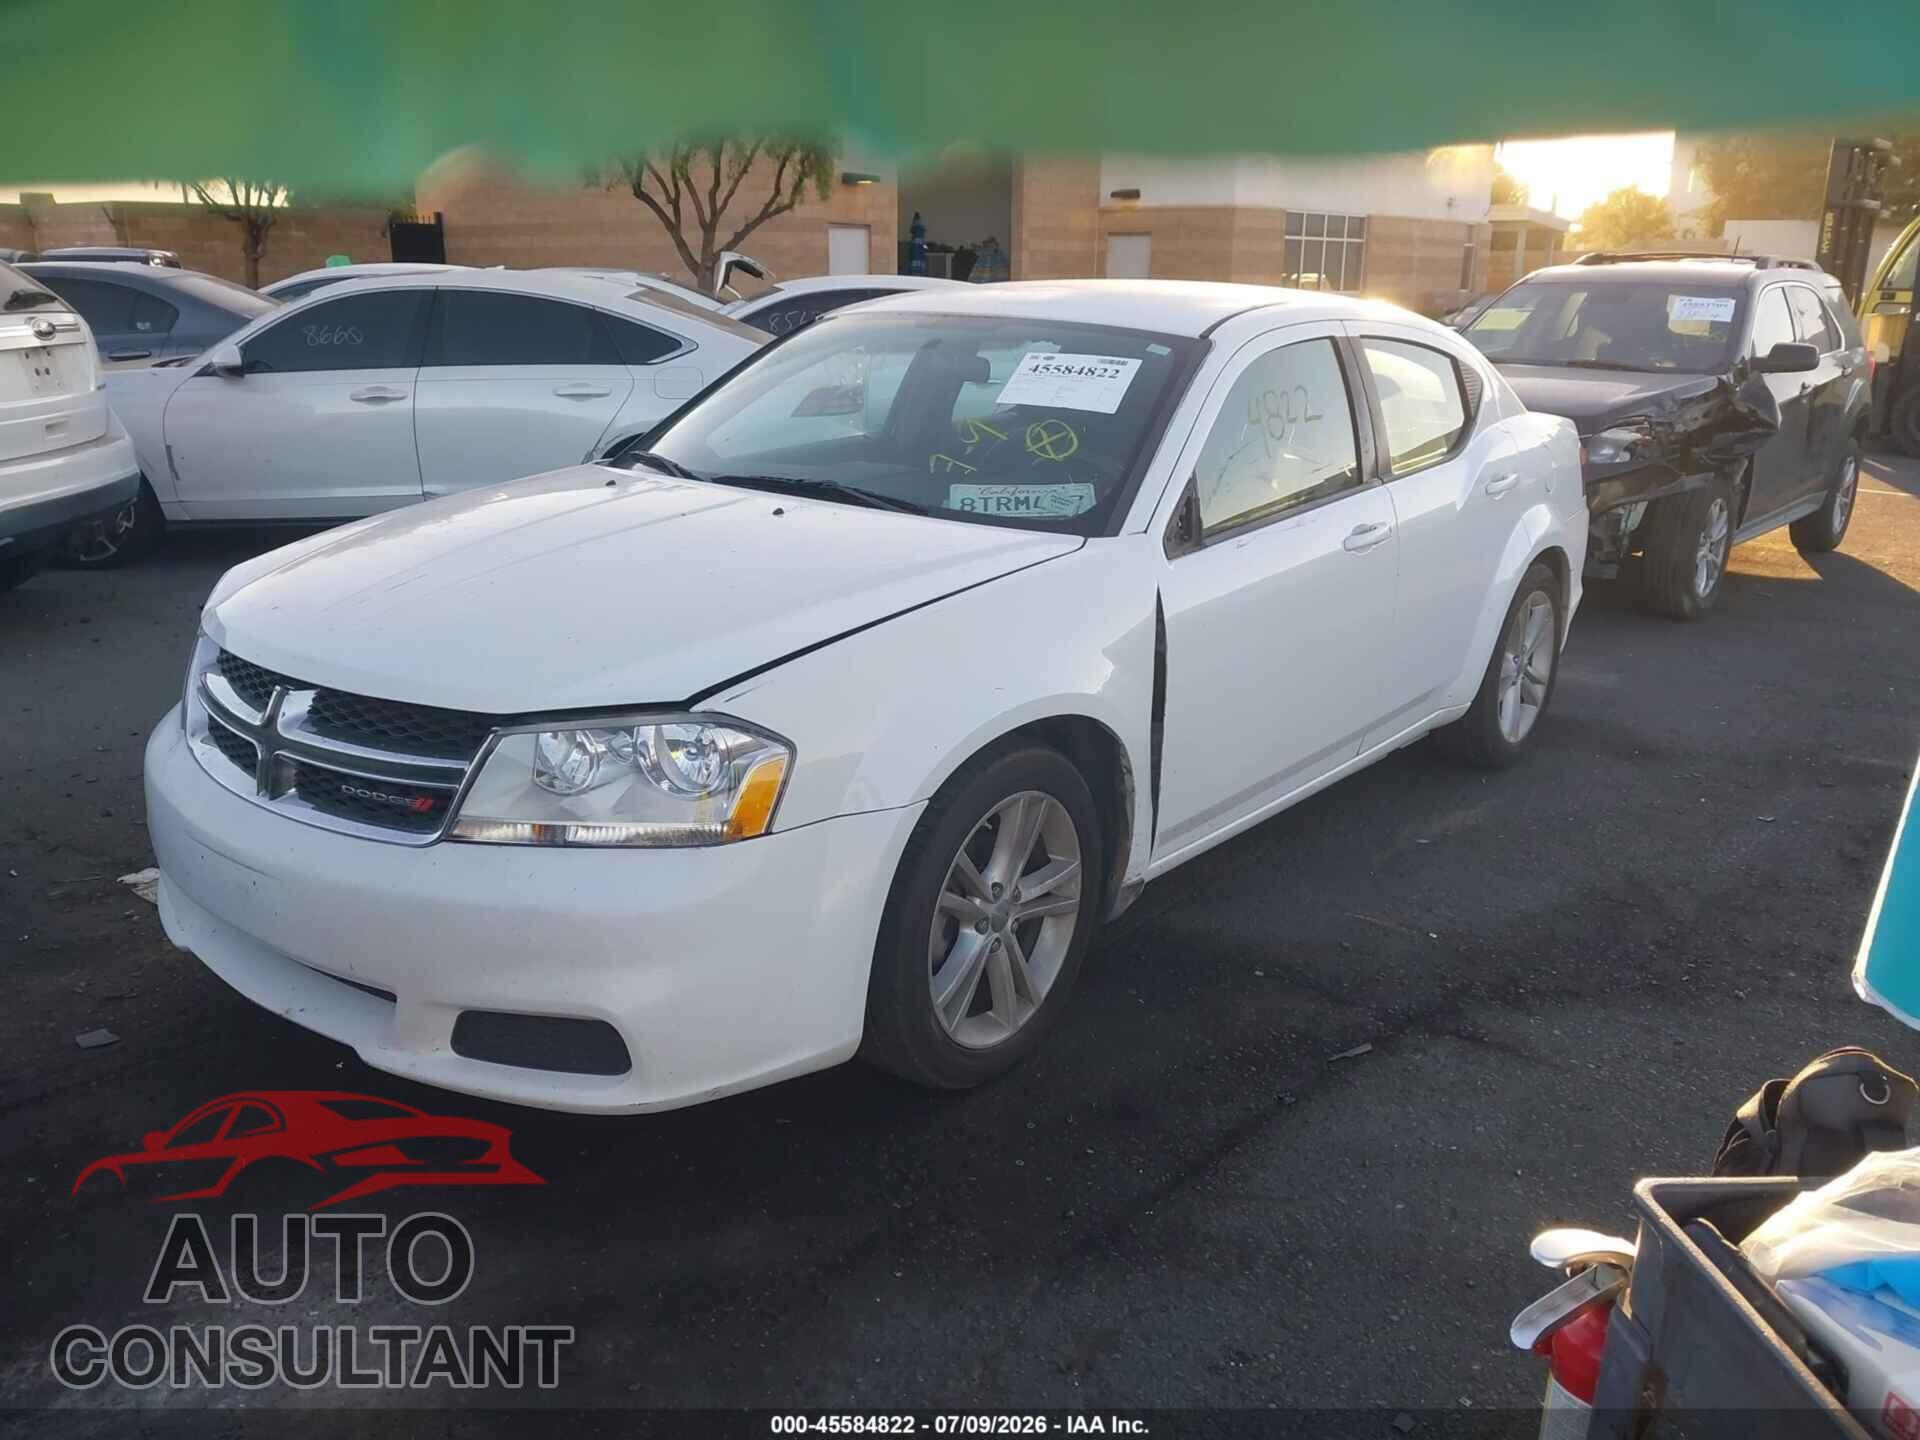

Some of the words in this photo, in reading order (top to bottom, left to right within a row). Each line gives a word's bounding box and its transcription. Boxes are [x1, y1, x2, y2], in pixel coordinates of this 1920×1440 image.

[1821, 212, 1834, 254] HYSTER
[1028, 363, 1121, 380] 45584822
[1248, 385, 1324, 453] 4822
[341, 784, 417, 807] DODGE
